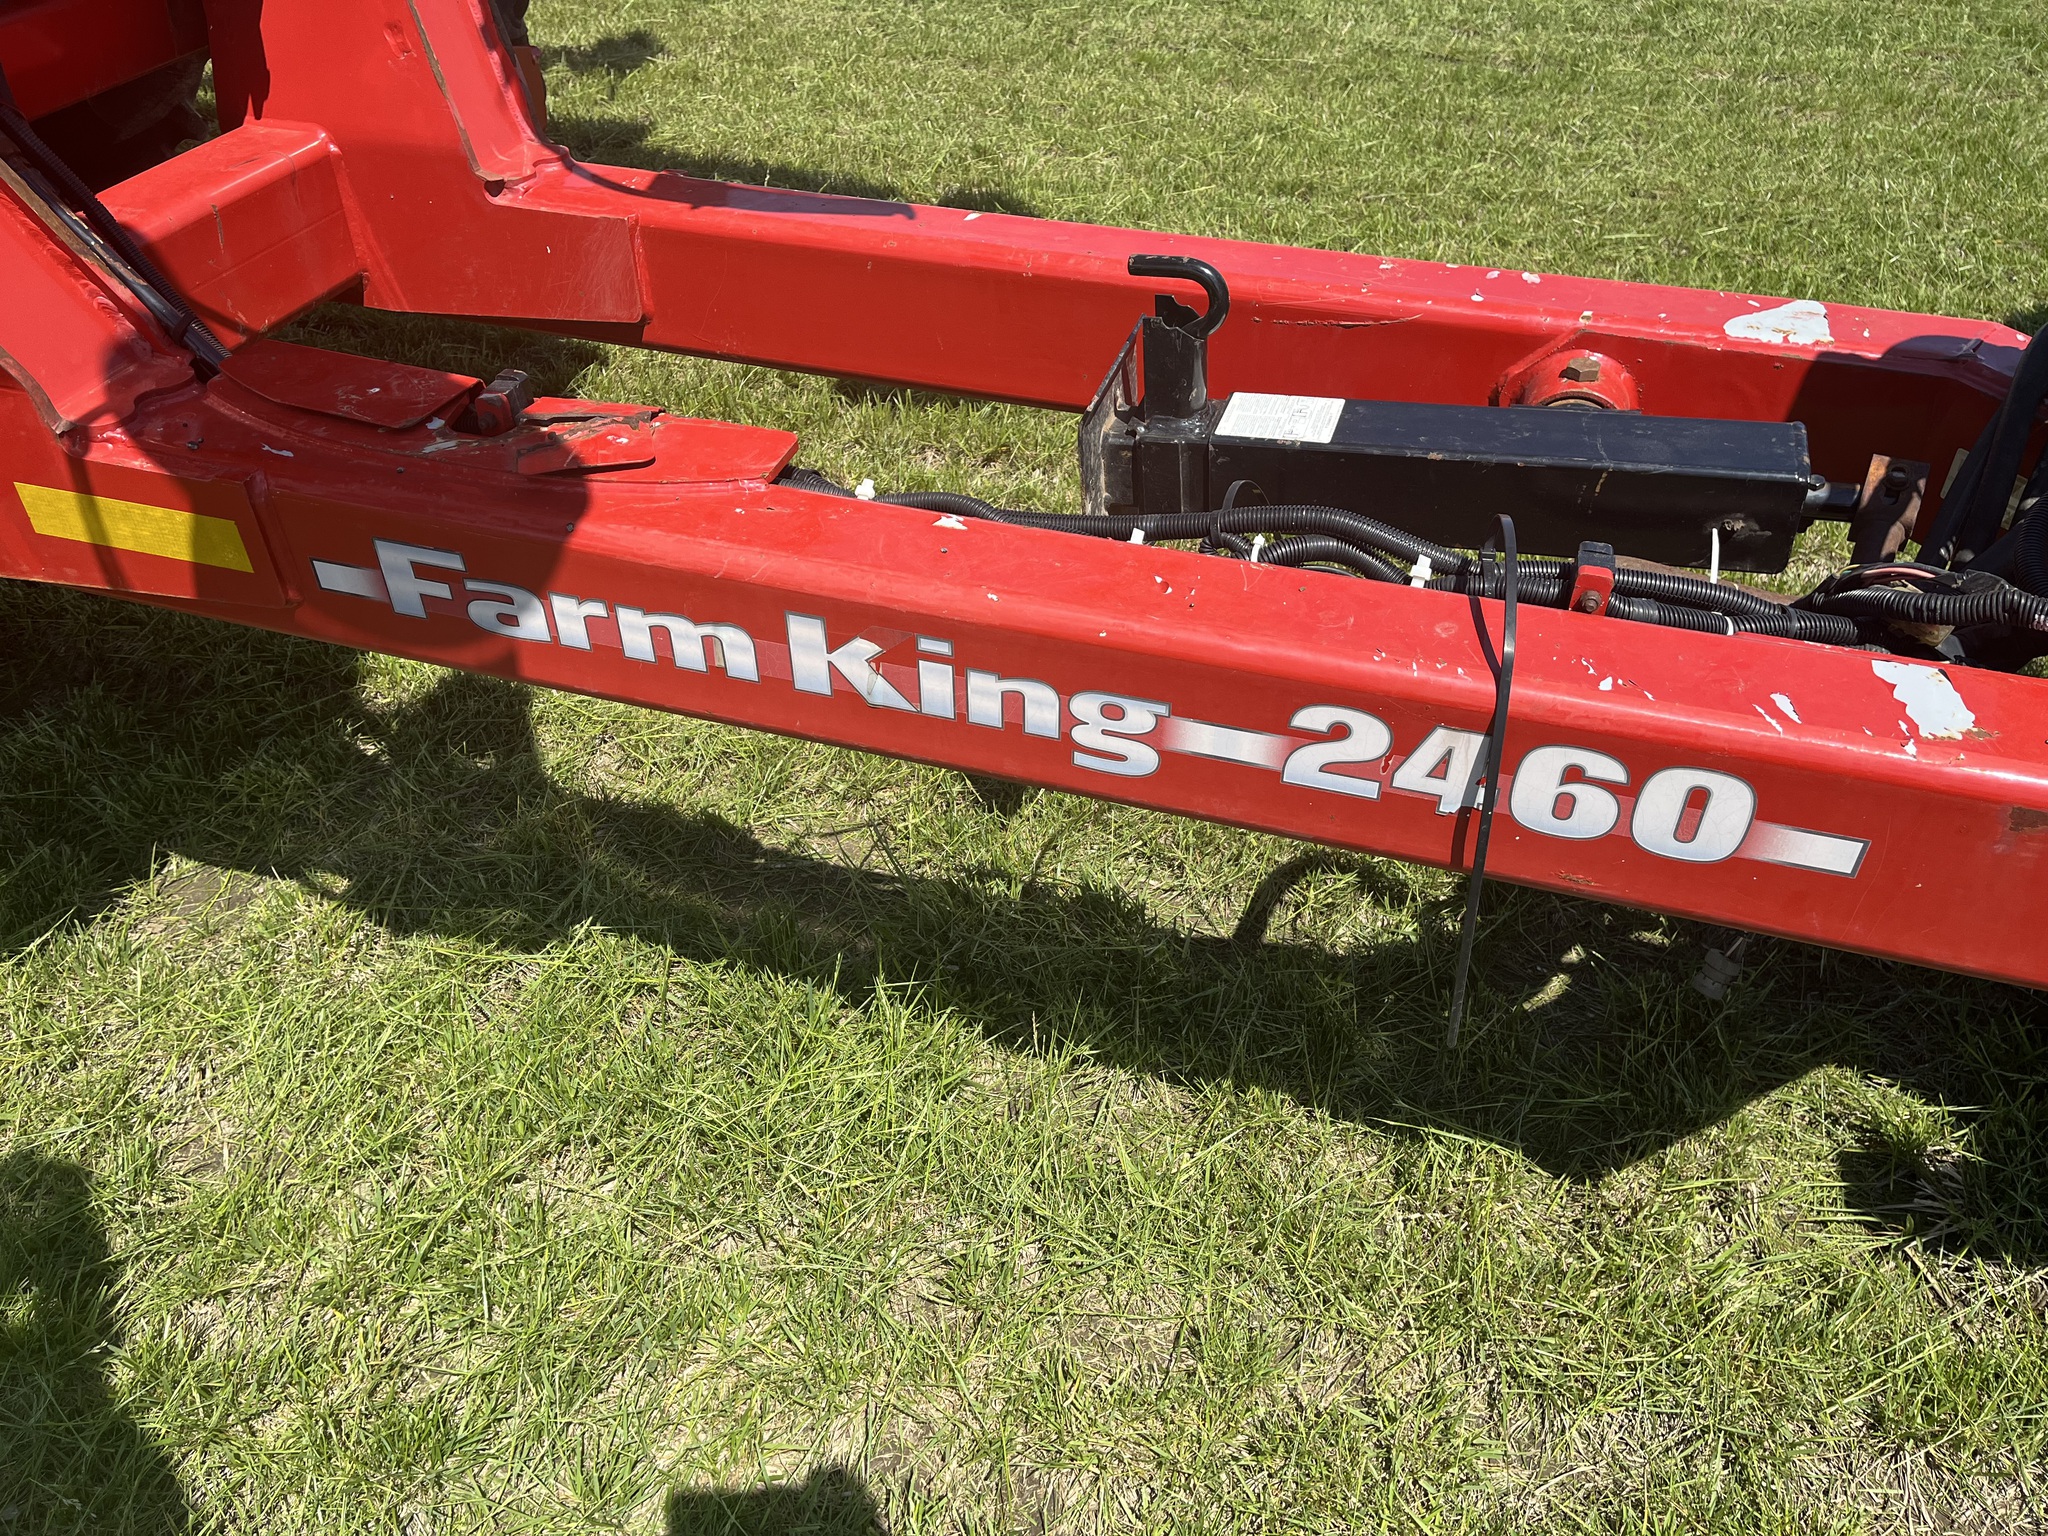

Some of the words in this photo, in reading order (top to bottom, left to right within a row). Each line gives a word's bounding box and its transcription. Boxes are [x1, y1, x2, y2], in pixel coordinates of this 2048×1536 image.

[372, 537, 761, 684] Farm
[784, 609, 1171, 778] King
[1280, 704, 1757, 864] 2460
